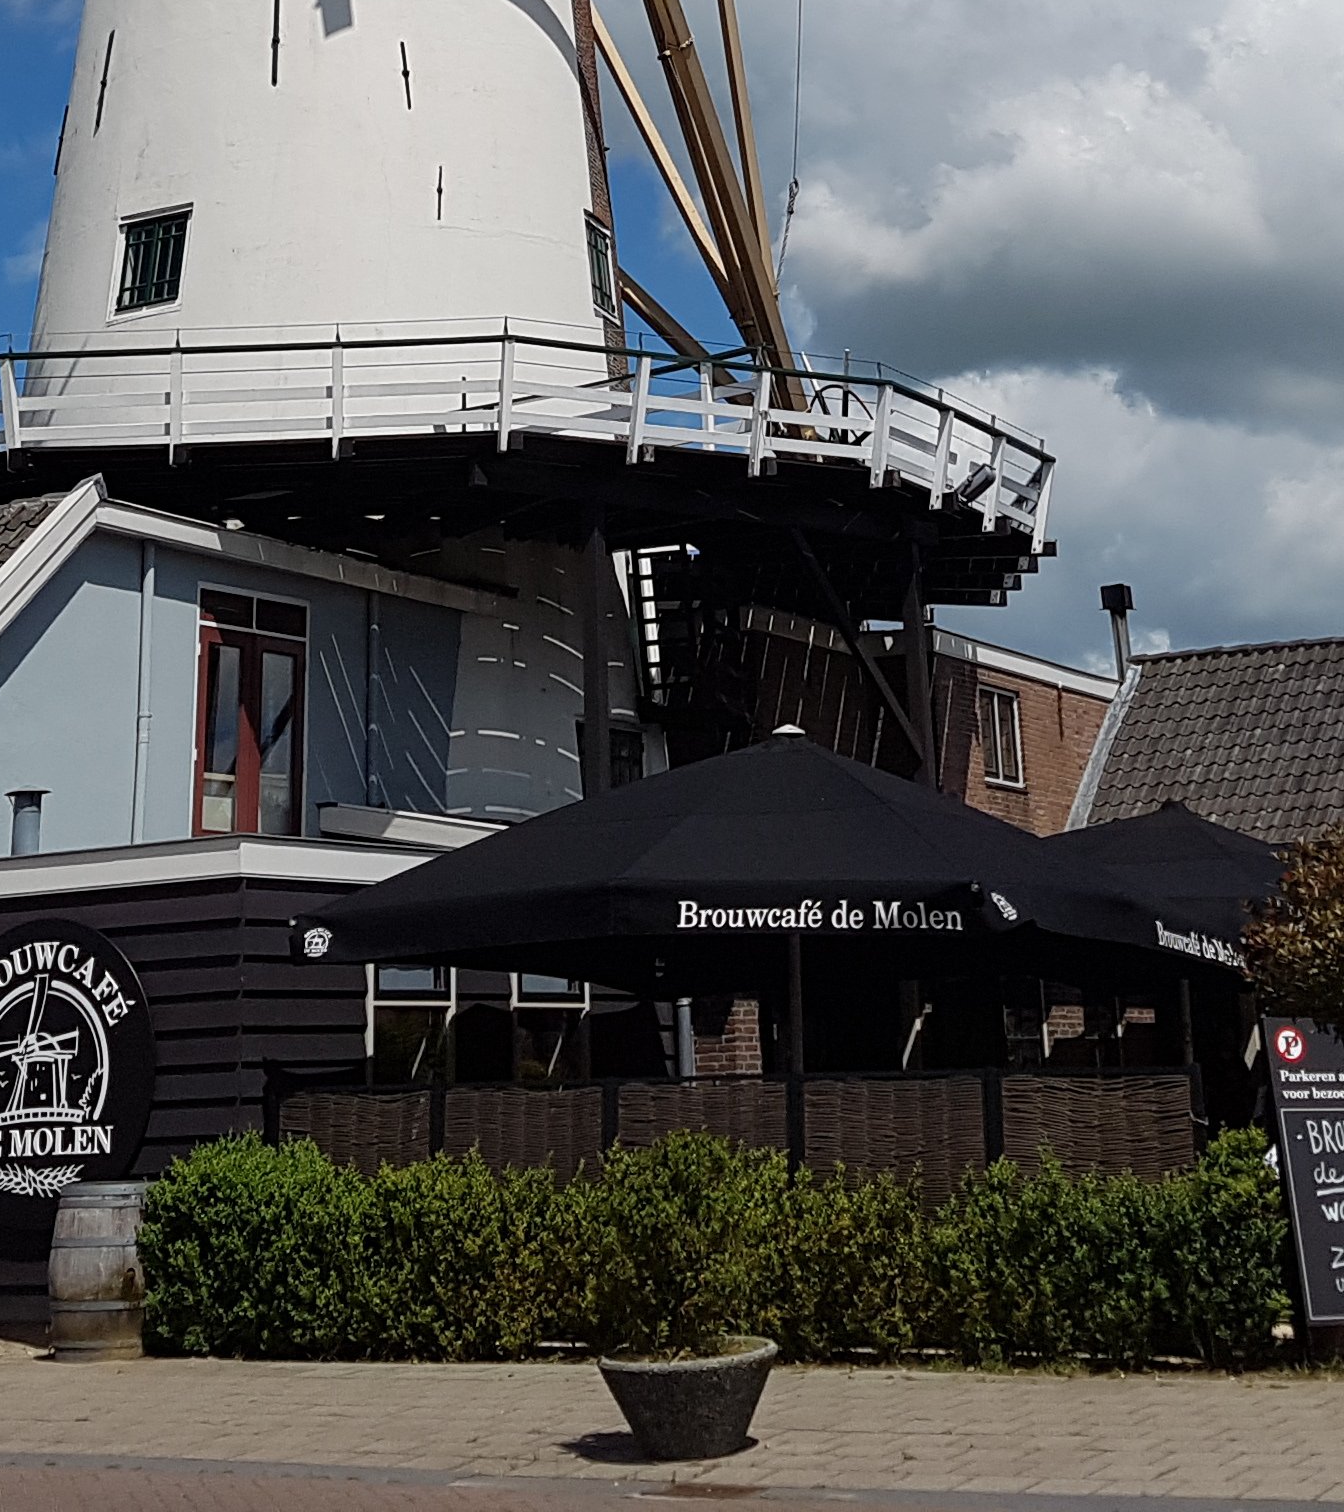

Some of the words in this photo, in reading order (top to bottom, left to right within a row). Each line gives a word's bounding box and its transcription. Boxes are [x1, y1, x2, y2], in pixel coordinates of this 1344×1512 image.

[676, 899, 823, 928] Brouwcafé
[831, 899, 864, 929] de
[872, 900, 964, 931] Molen
[1201, 934, 1217, 960] de
[1279, 1069, 1336, 1082] Parkeren
[1282, 1090, 1310, 1100] voor
[8, 1125, 114, 1157] MOLEN
